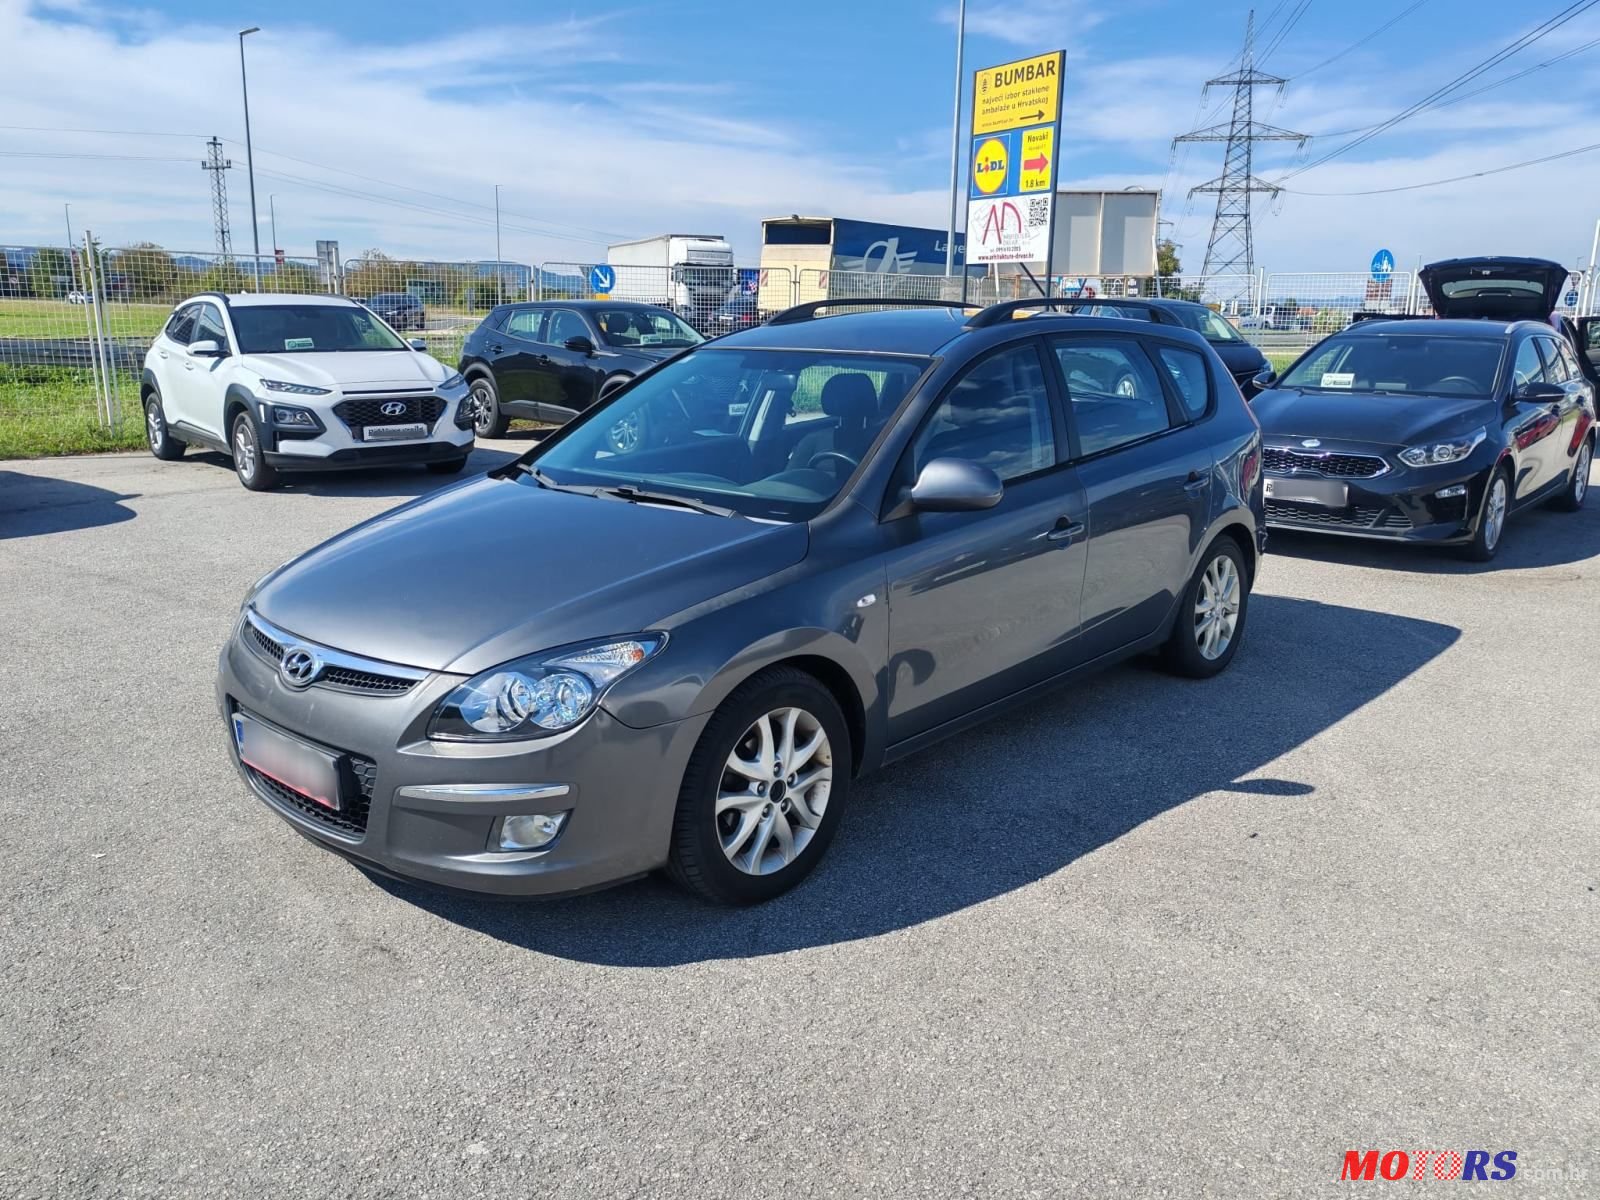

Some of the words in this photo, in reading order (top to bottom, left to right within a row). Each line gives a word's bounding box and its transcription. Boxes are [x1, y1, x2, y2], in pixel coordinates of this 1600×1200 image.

[994, 60, 1056, 88] BUMBAR
[1004, 91, 1021, 101] izbor
[1021, 85, 1049, 97] staklene
[1017, 97, 1049, 109] Hrvatskoj
[1036, 178, 1045, 187] km
